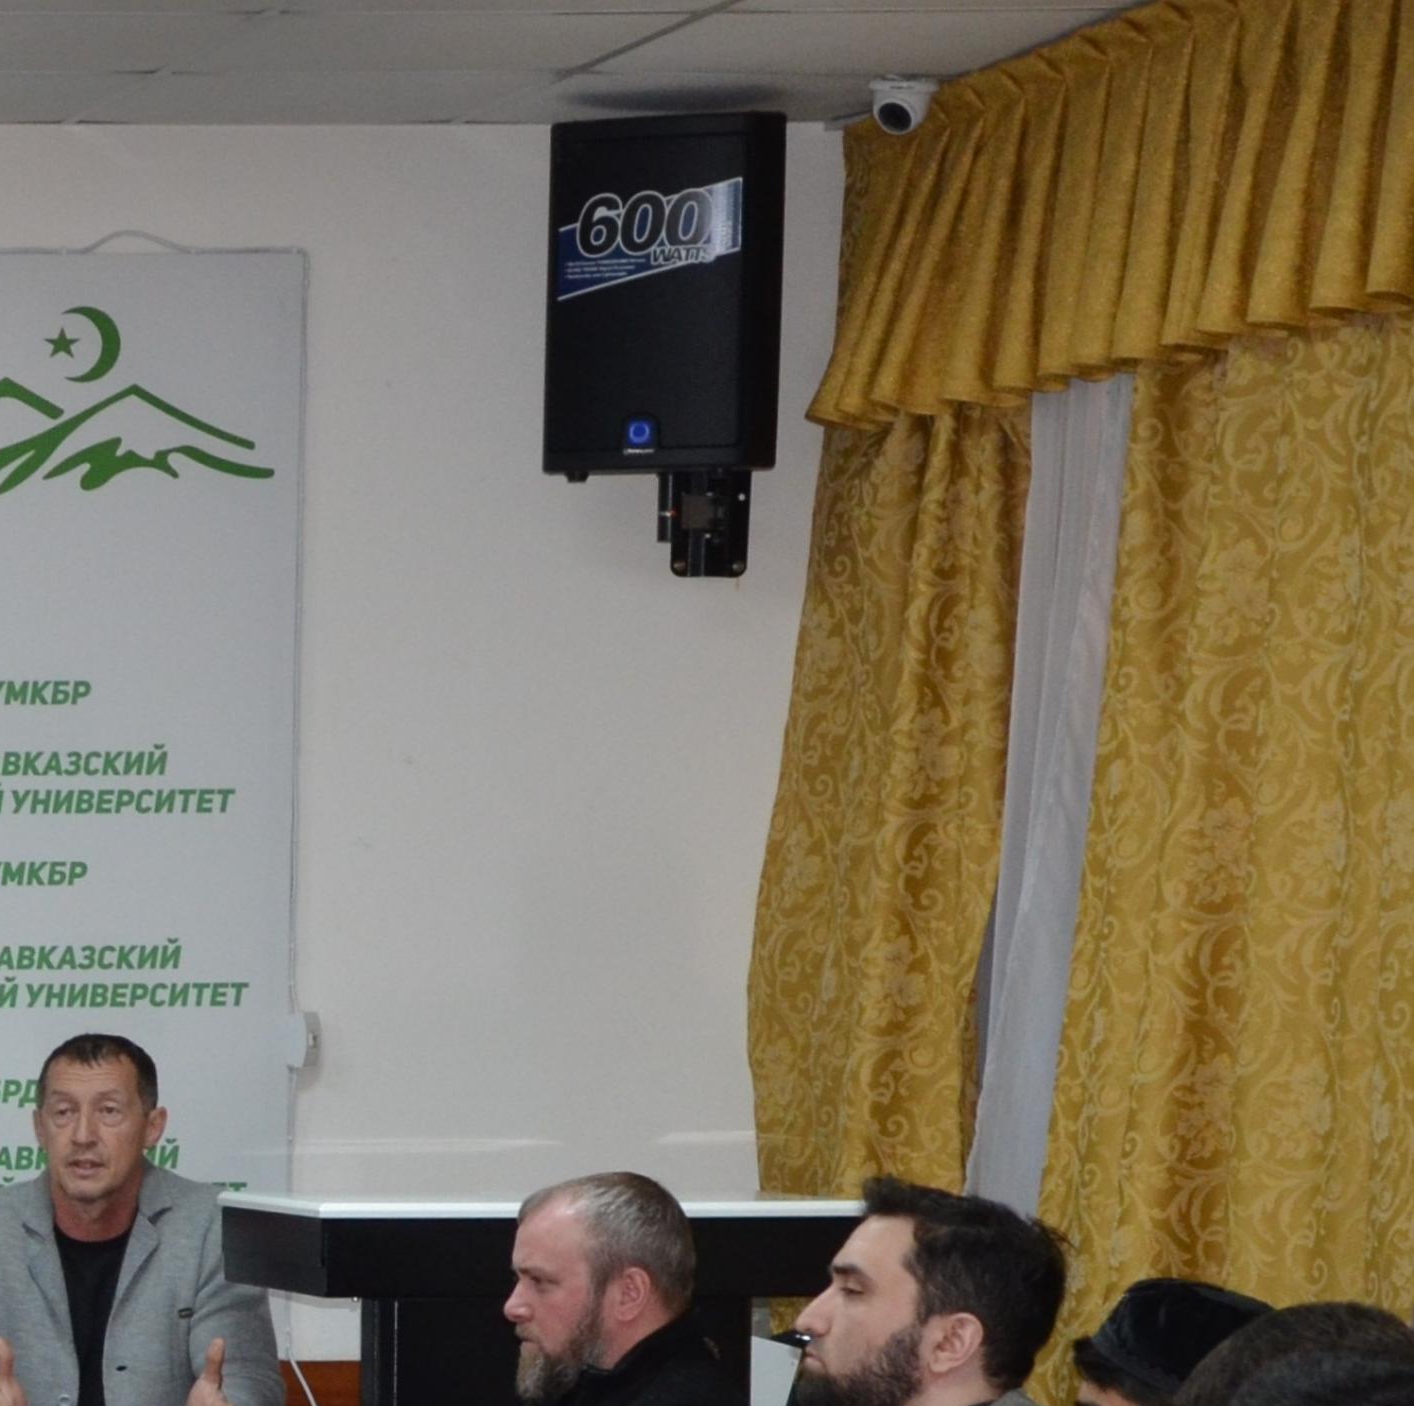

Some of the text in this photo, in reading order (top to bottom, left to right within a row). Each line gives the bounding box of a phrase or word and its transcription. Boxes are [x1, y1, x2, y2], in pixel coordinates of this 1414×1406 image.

[576, 188, 713, 258] 600
[11, 788, 236, 815] УНИВЕРСИТЕТ
[26, 982, 250, 1008] УНИВЕРСИТЕТ
